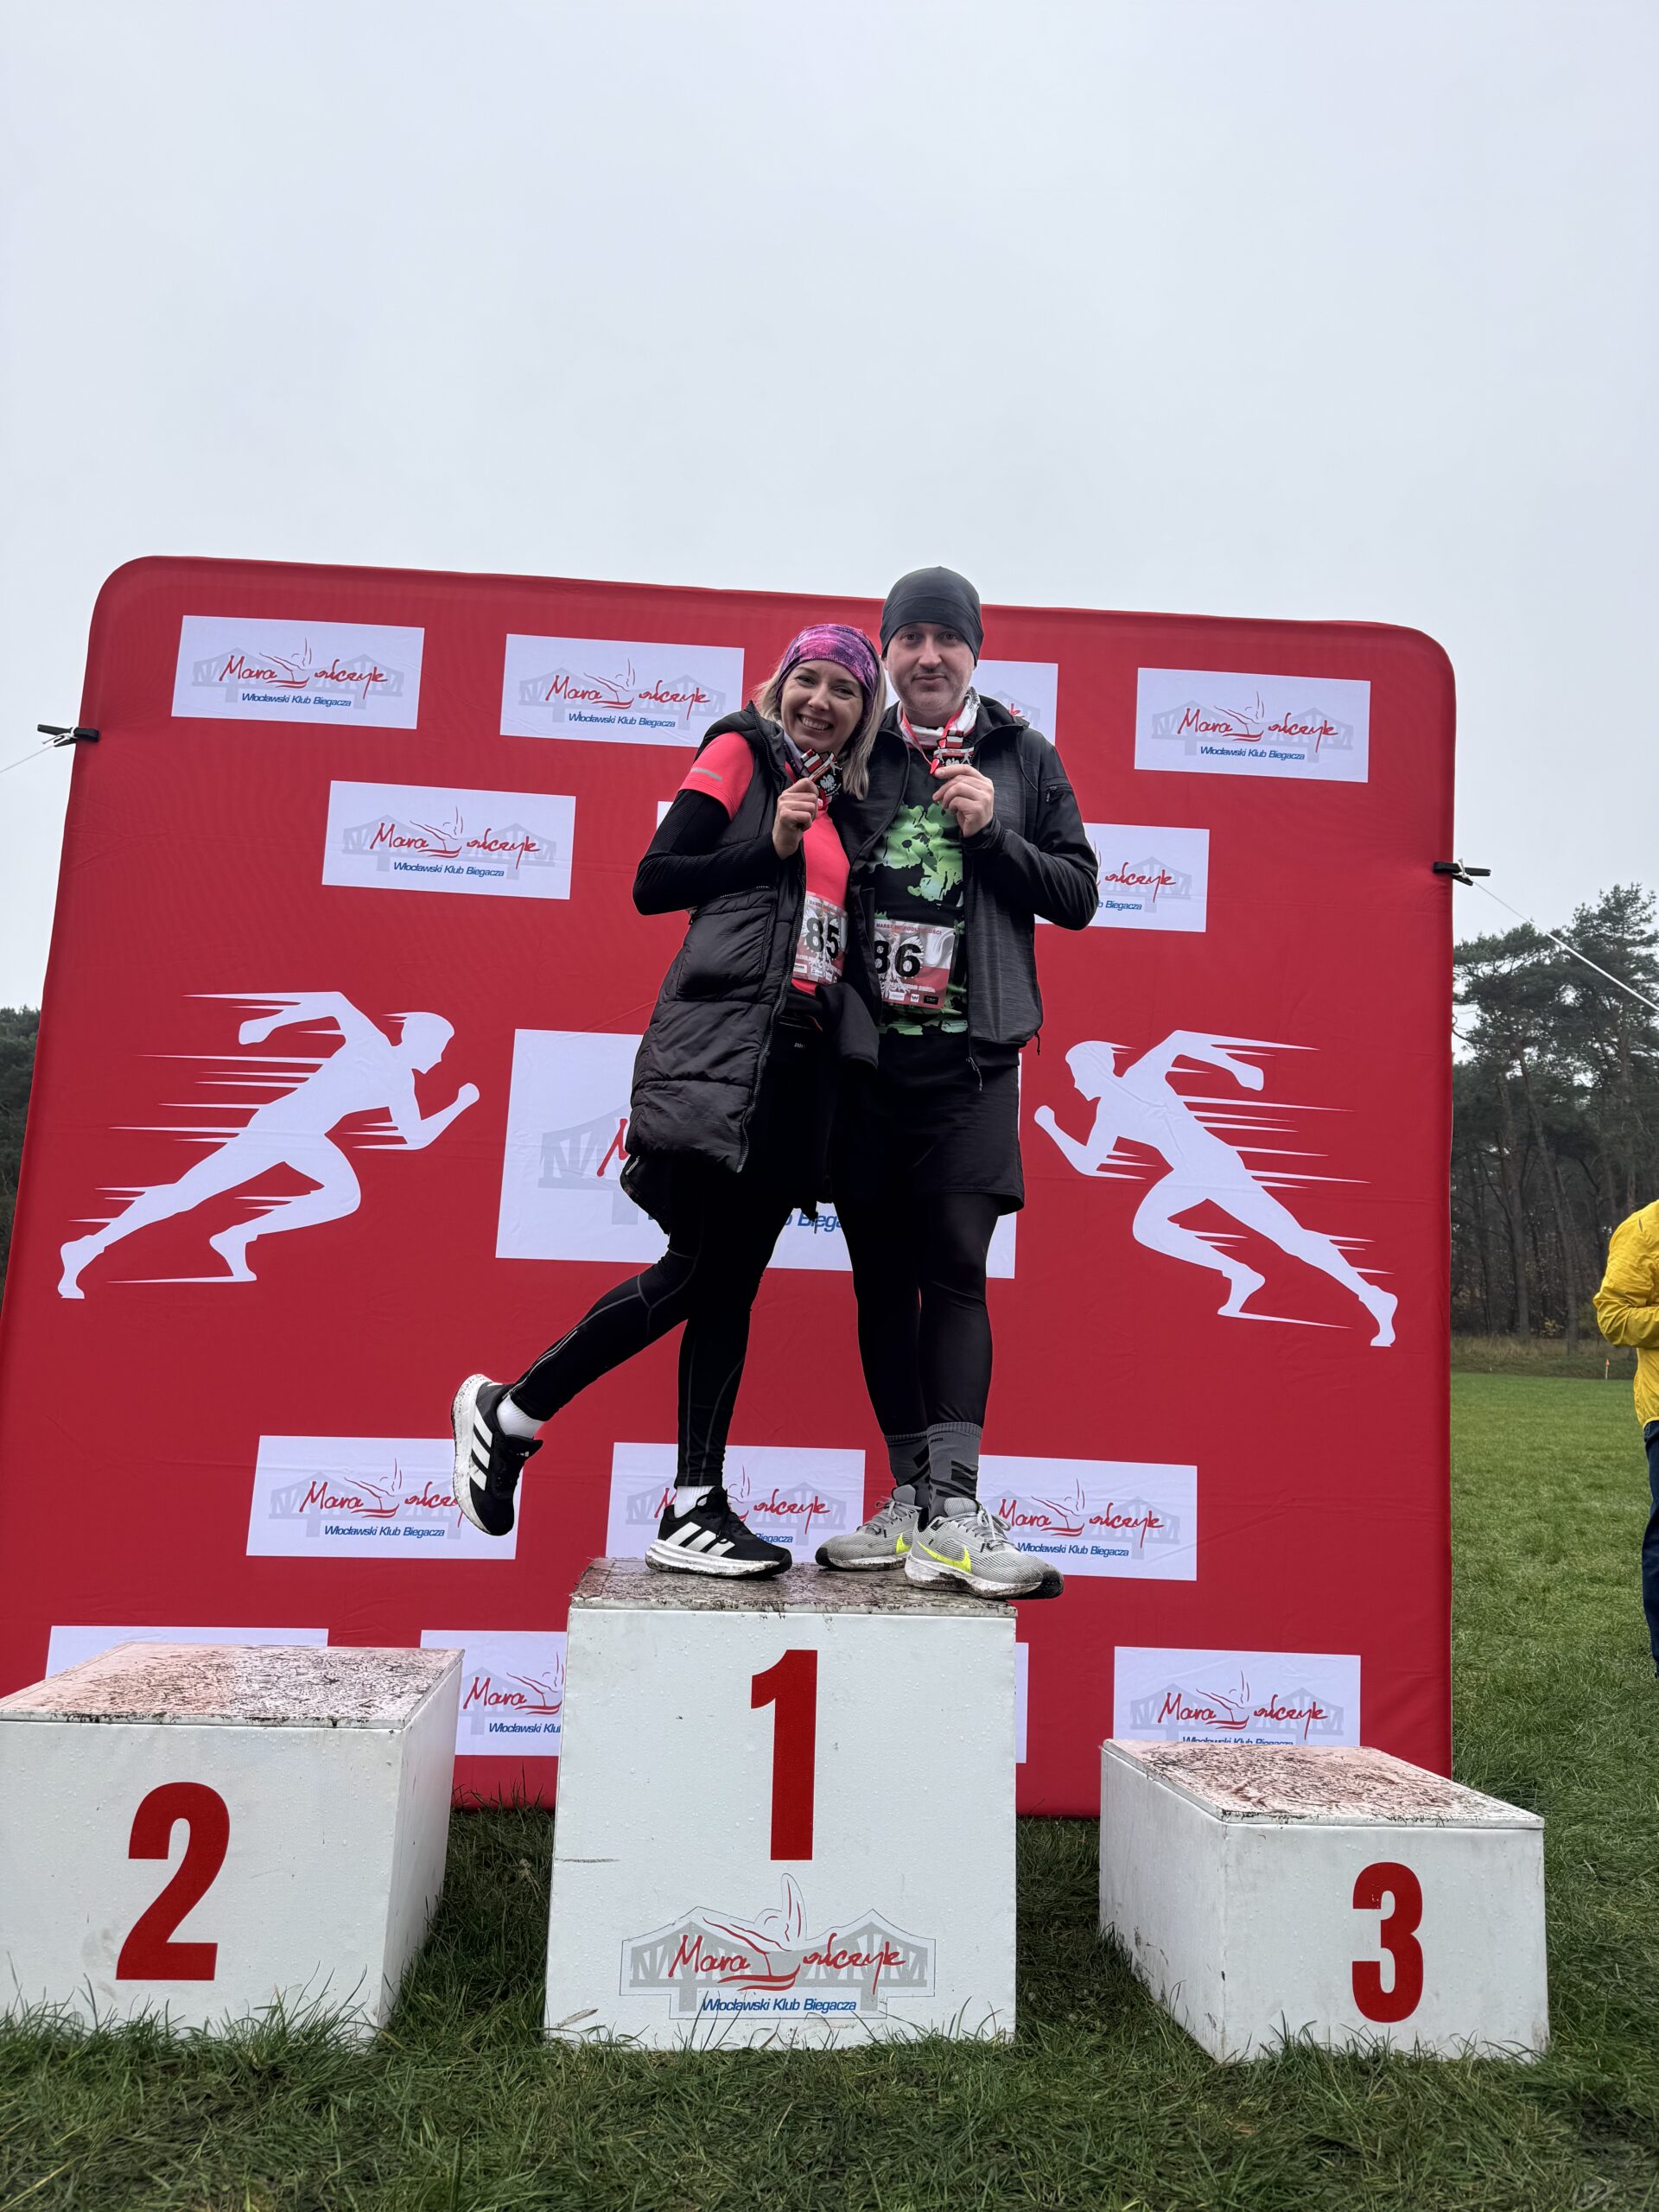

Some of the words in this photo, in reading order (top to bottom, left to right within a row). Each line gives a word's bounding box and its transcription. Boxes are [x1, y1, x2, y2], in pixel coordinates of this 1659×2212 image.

[242, 693, 289, 703] Włocławski
[291, 695, 311, 704] Klub
[313, 696, 352, 707] Biegacza
[569, 713, 615, 724] Włocławski
[617, 715, 637, 725] Klub
[639, 717, 676, 728] Biegacza
[1200, 746, 1246, 757] Włocławski
[1248, 749, 1267, 758] Klub
[1268, 750, 1305, 760] Biegacza
[393, 861, 443, 874] Włocławski
[444, 865, 464, 874] Klub
[466, 867, 505, 877] Biegacza
[1105, 900, 1142, 912] Biegacza
[806, 917, 841, 959] 85
[874, 940, 921, 977] 86
[324, 1525, 378, 1536] Włocławski
[379, 1527, 401, 1536] Klub
[403, 1527, 445, 1539] Biegacza
[1017, 1541, 1067, 1554] Włocławski
[1068, 1544, 1088, 1554] Klub
[1090, 1546, 1129, 1557] Biegacza
[489, 1722, 542, 1733] Włocławski
[751, 1649, 817, 1860] 1
[116, 1782, 230, 1980] 2
[1352, 1862, 1424, 2023] 3
[701, 1998, 770, 2012] Włocławski
[772, 1999, 800, 2011] Klub
[804, 1999, 857, 2014] Biegacza
